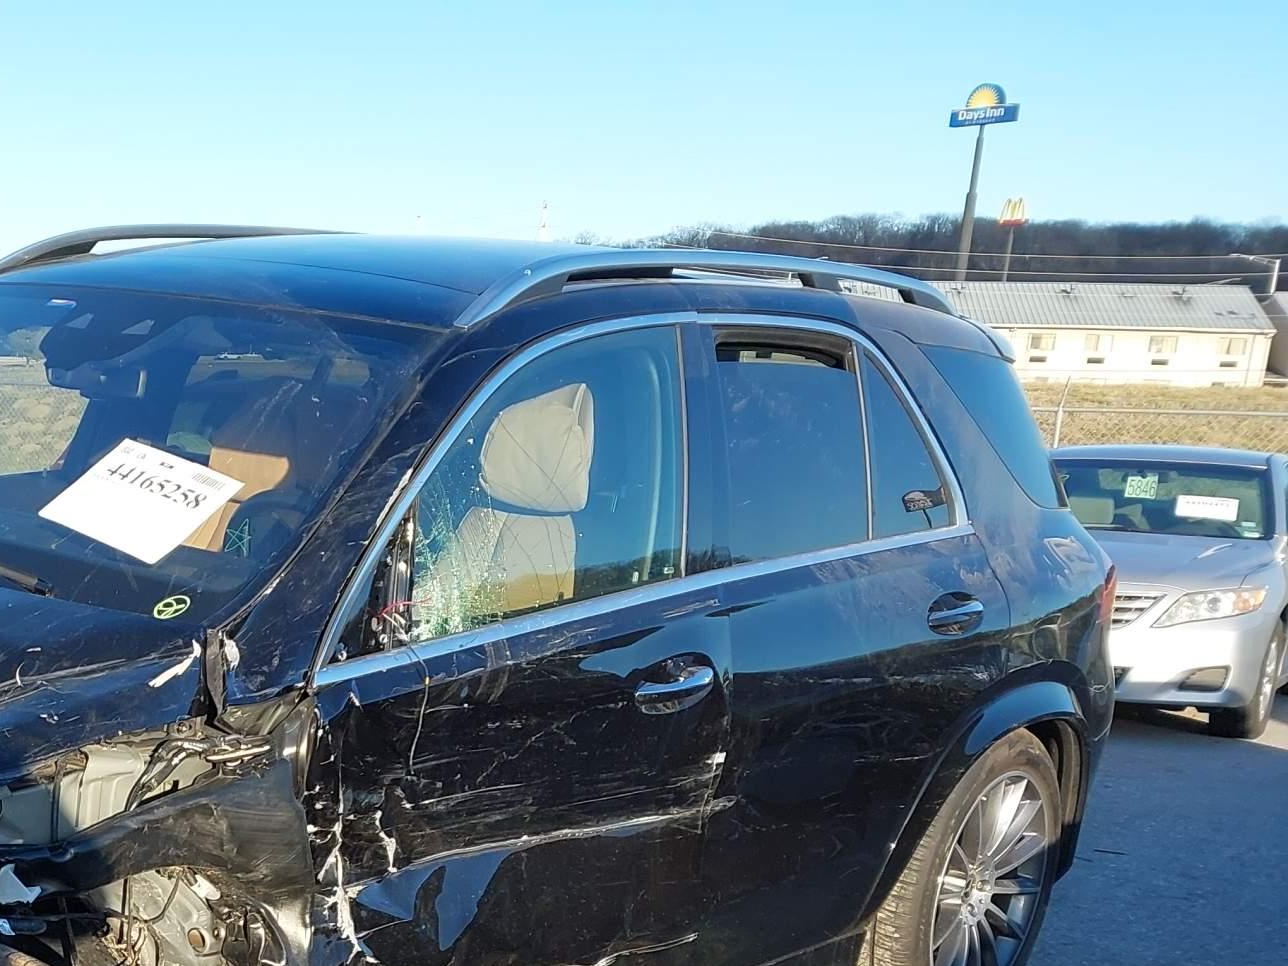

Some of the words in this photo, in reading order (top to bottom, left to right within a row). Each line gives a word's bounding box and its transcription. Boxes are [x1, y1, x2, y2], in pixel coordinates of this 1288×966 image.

[958, 110, 986, 121] Days
[985, 108, 1005, 119] Inn
[107, 463, 207, 509] 44165258
[1127, 479, 1157, 497] 5846
